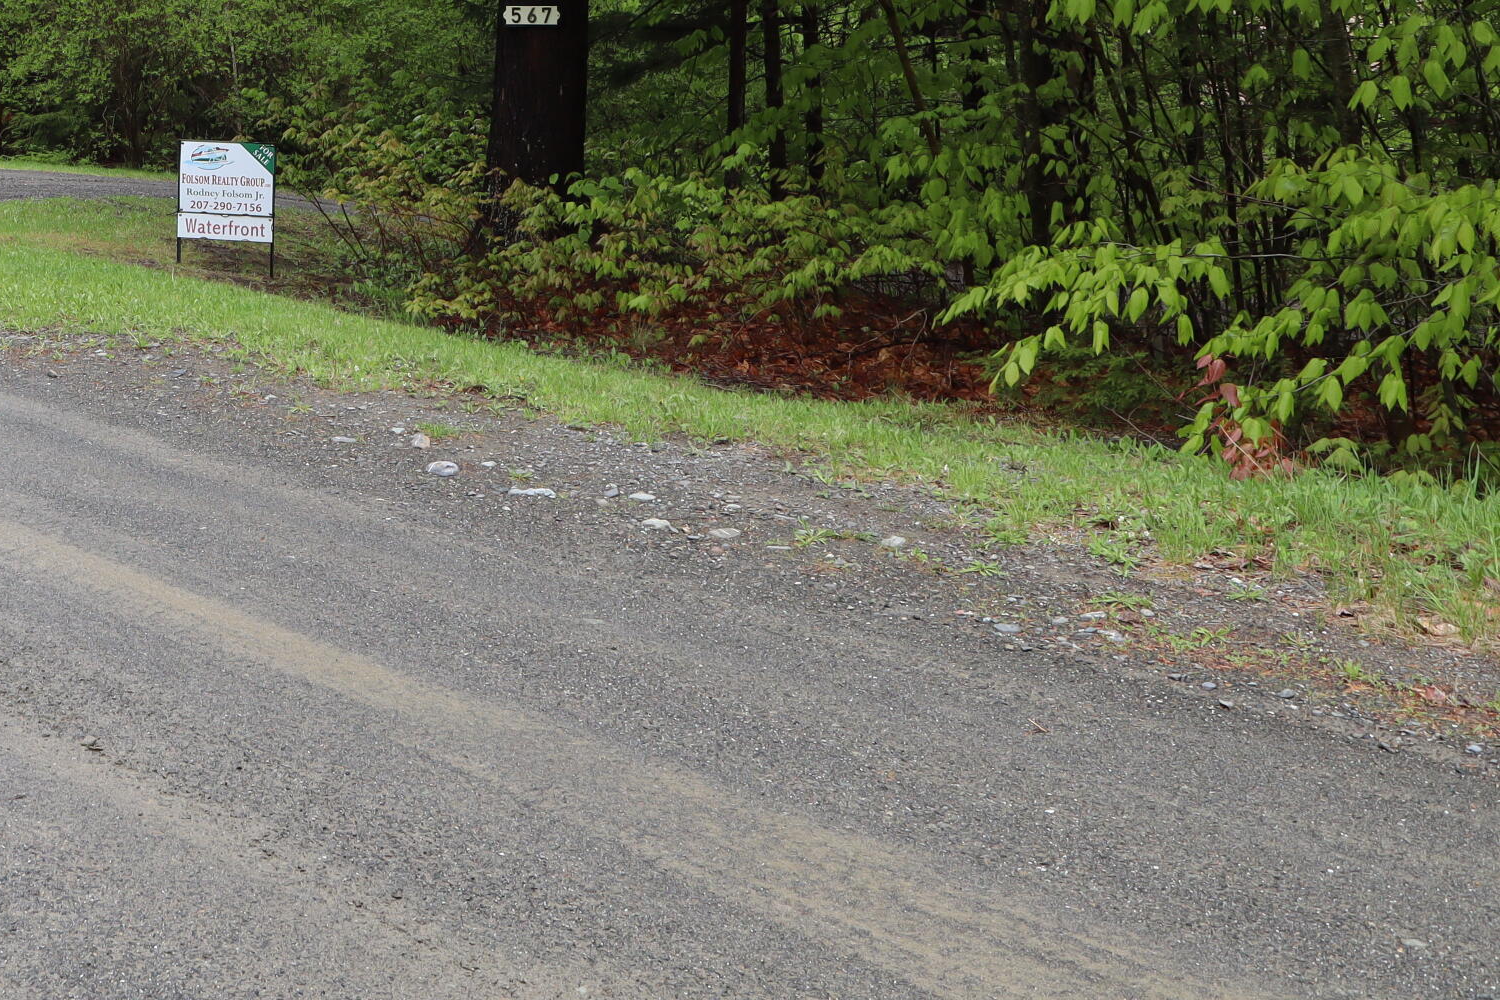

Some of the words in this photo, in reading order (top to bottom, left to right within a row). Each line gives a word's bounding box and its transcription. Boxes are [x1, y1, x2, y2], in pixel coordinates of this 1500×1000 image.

[511, 7, 552, 23] 567
[252, 150, 269, 166] SALE
[259, 144, 274, 159] FOR
[182, 173, 210, 186] FOLSOM
[211, 174, 238, 187] REALTY
[240, 175, 265, 188] GROUP
[186, 188, 219, 200] Rodney
[222, 189, 253, 199] Folsom
[255, 191, 265, 201] Jr.
[190, 200, 262, 213] 207-290-7156
[185, 217, 266, 237] Waterfront
